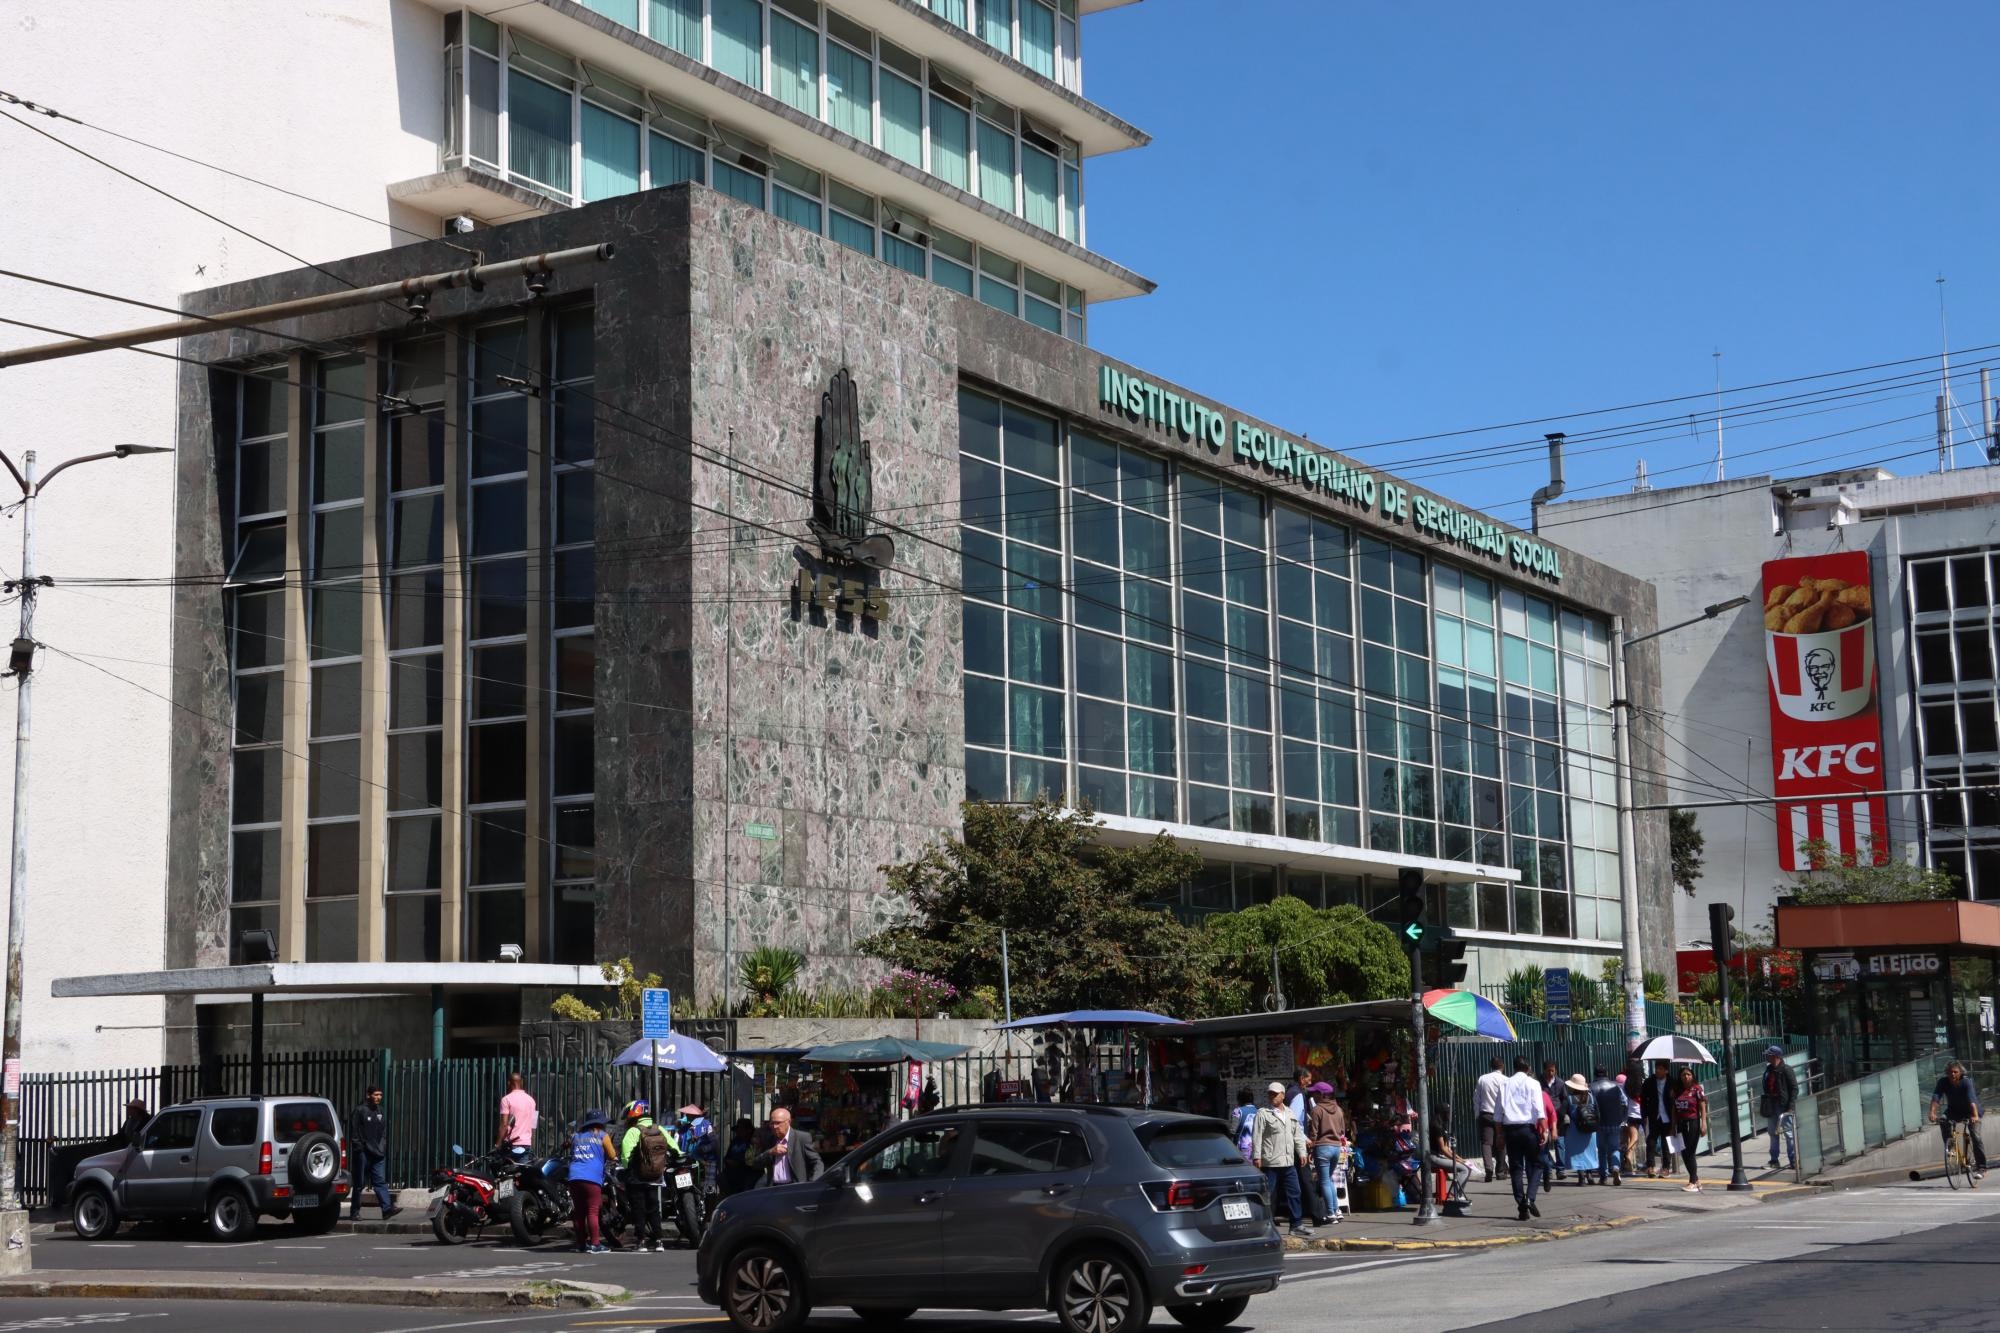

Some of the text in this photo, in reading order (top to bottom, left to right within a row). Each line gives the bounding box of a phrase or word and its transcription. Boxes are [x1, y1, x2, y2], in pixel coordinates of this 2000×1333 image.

[1101, 366, 1563, 580] INSTITUTO ECUATORIANO DE SEGURIDAD SOCIAL
[799, 569, 890, 621] IESS
[1810, 701, 1836, 712] KFC
[1778, 742, 1876, 780] KFC
[1869, 954, 1940, 976] El Ejido
[645, 991, 651, 1001] E
